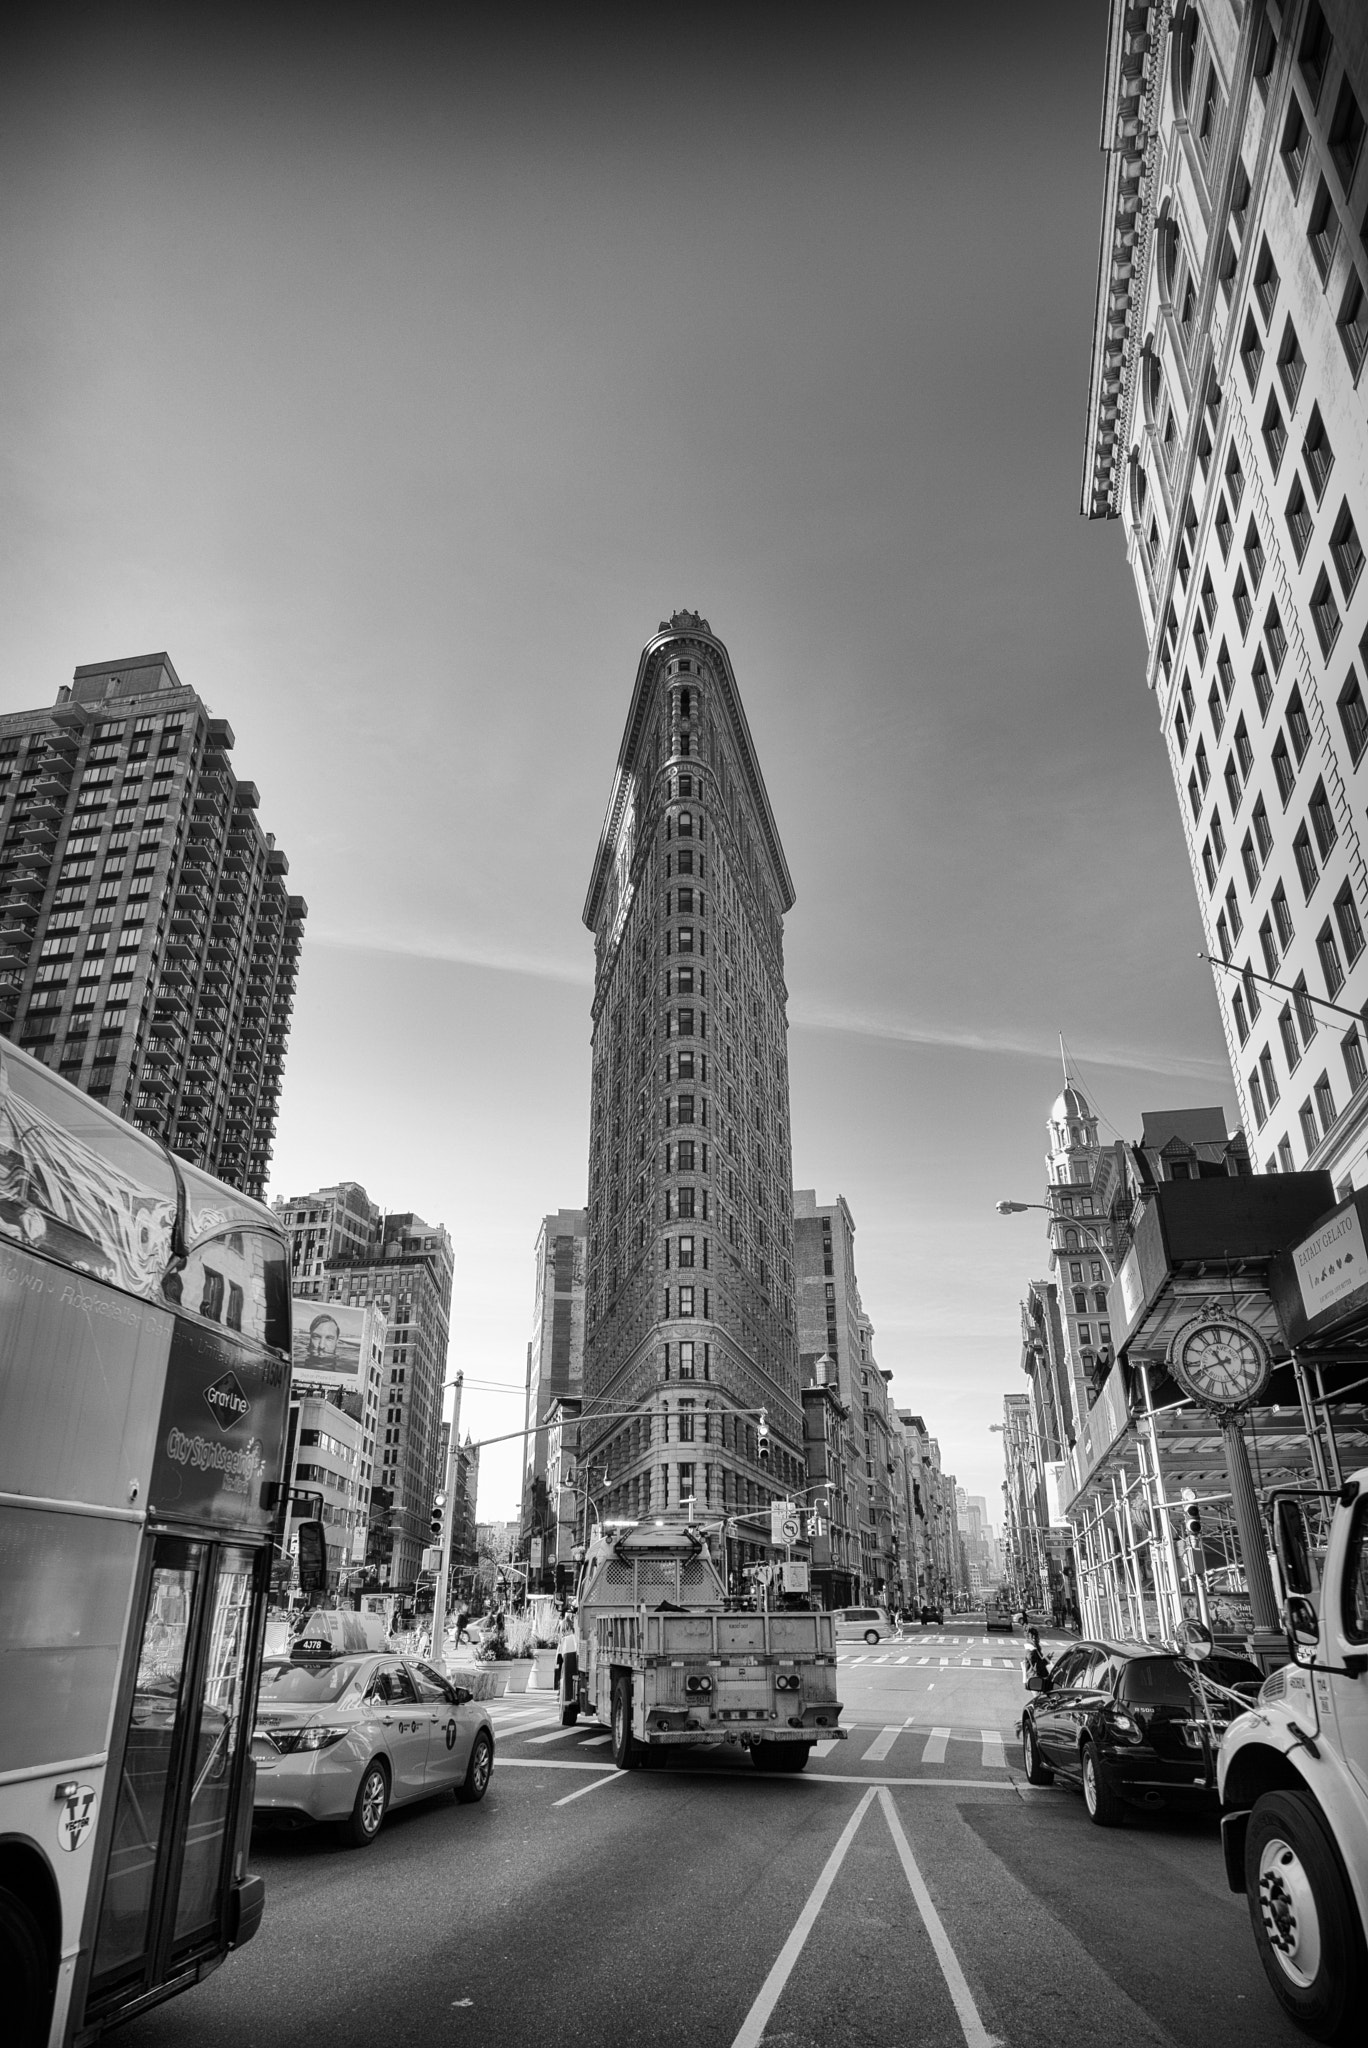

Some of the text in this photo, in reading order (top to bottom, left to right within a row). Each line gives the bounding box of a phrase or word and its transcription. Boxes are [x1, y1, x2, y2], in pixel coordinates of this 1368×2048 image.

[1298, 1217, 1352, 1267] EATALY GELATO
[1216, 1345, 1238, 1360] AVENUE
[303, 1640, 321, 1649] 4J78
[65, 1817, 89, 1831] VECTOR
